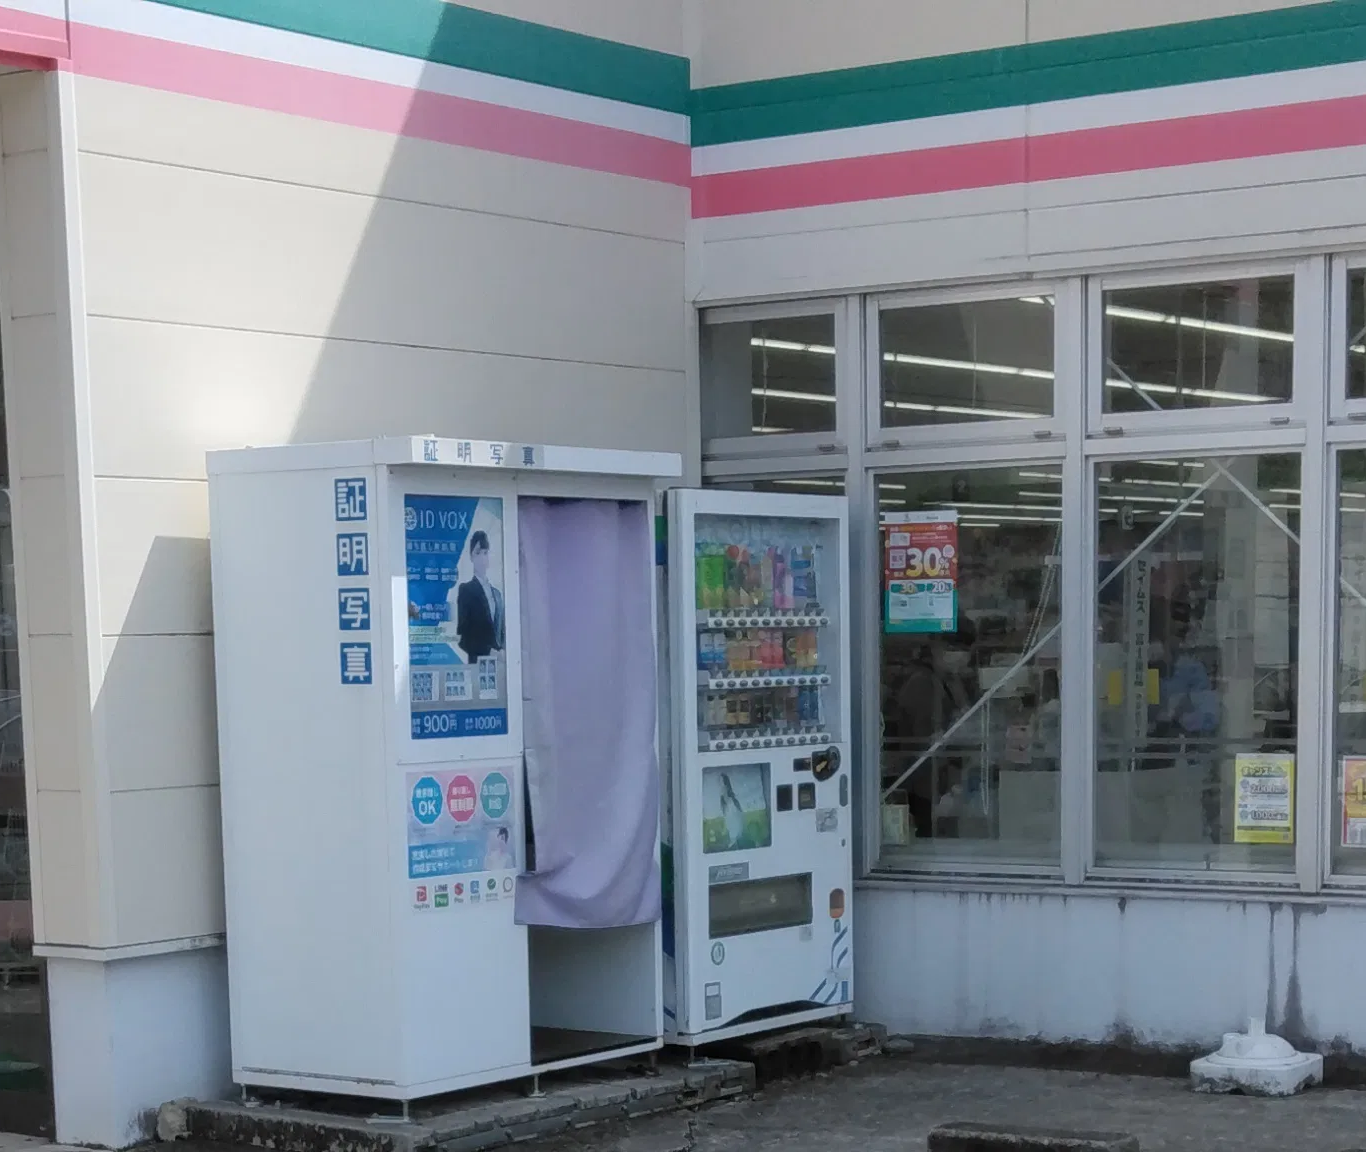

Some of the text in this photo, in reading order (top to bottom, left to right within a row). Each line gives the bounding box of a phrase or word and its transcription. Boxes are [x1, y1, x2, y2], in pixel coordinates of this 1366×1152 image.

[423, 439, 536, 467] 証明写真
[419, 509, 469, 530] ID VOX
[336, 481, 371, 682] 証明写真
[418, 800, 437, 816] OK
[434, 884, 448, 893] LINE
